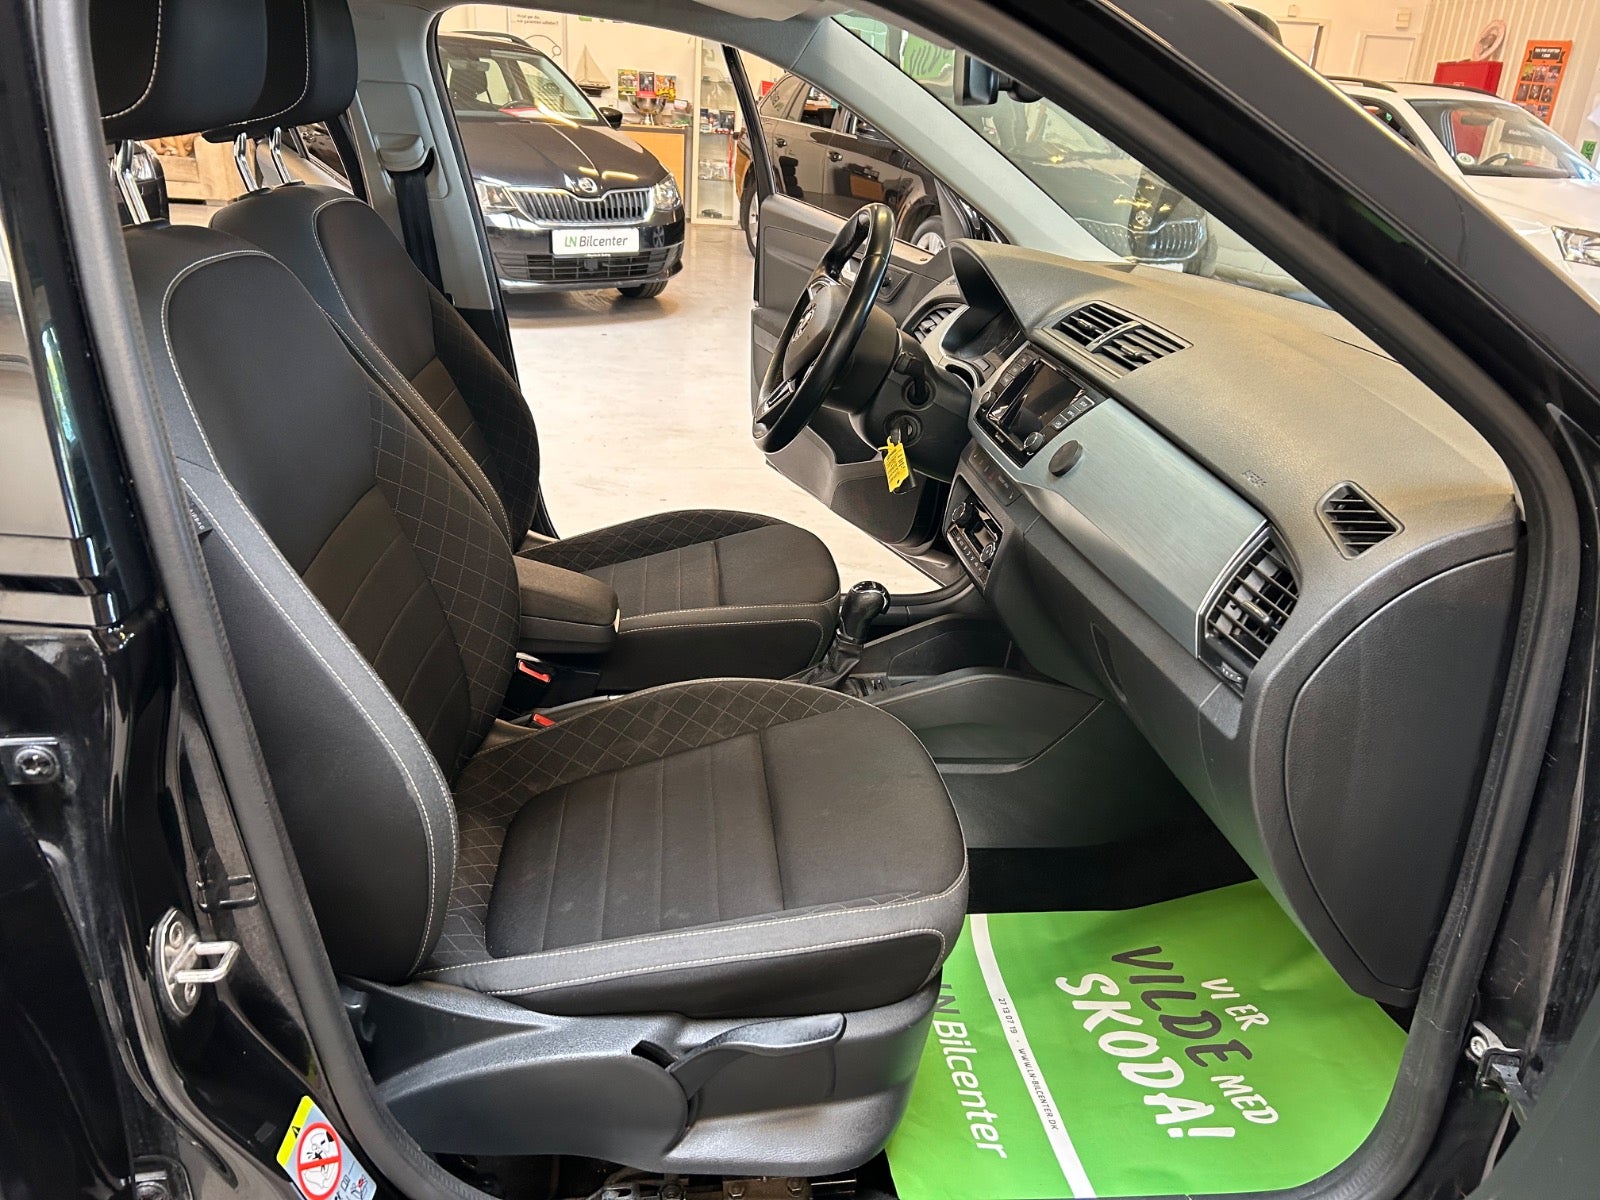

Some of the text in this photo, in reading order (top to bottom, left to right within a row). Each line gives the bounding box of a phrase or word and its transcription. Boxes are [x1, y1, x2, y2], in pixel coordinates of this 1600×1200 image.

[565, 235, 628, 247] LN Bilcenter
[1055, 973, 1236, 1138] SKODA!
[1112, 946, 1279, 1124] VILDE MED
[1201, 978, 1270, 1032] VI ER
[932, 1020, 1008, 1160] Bilcenter
